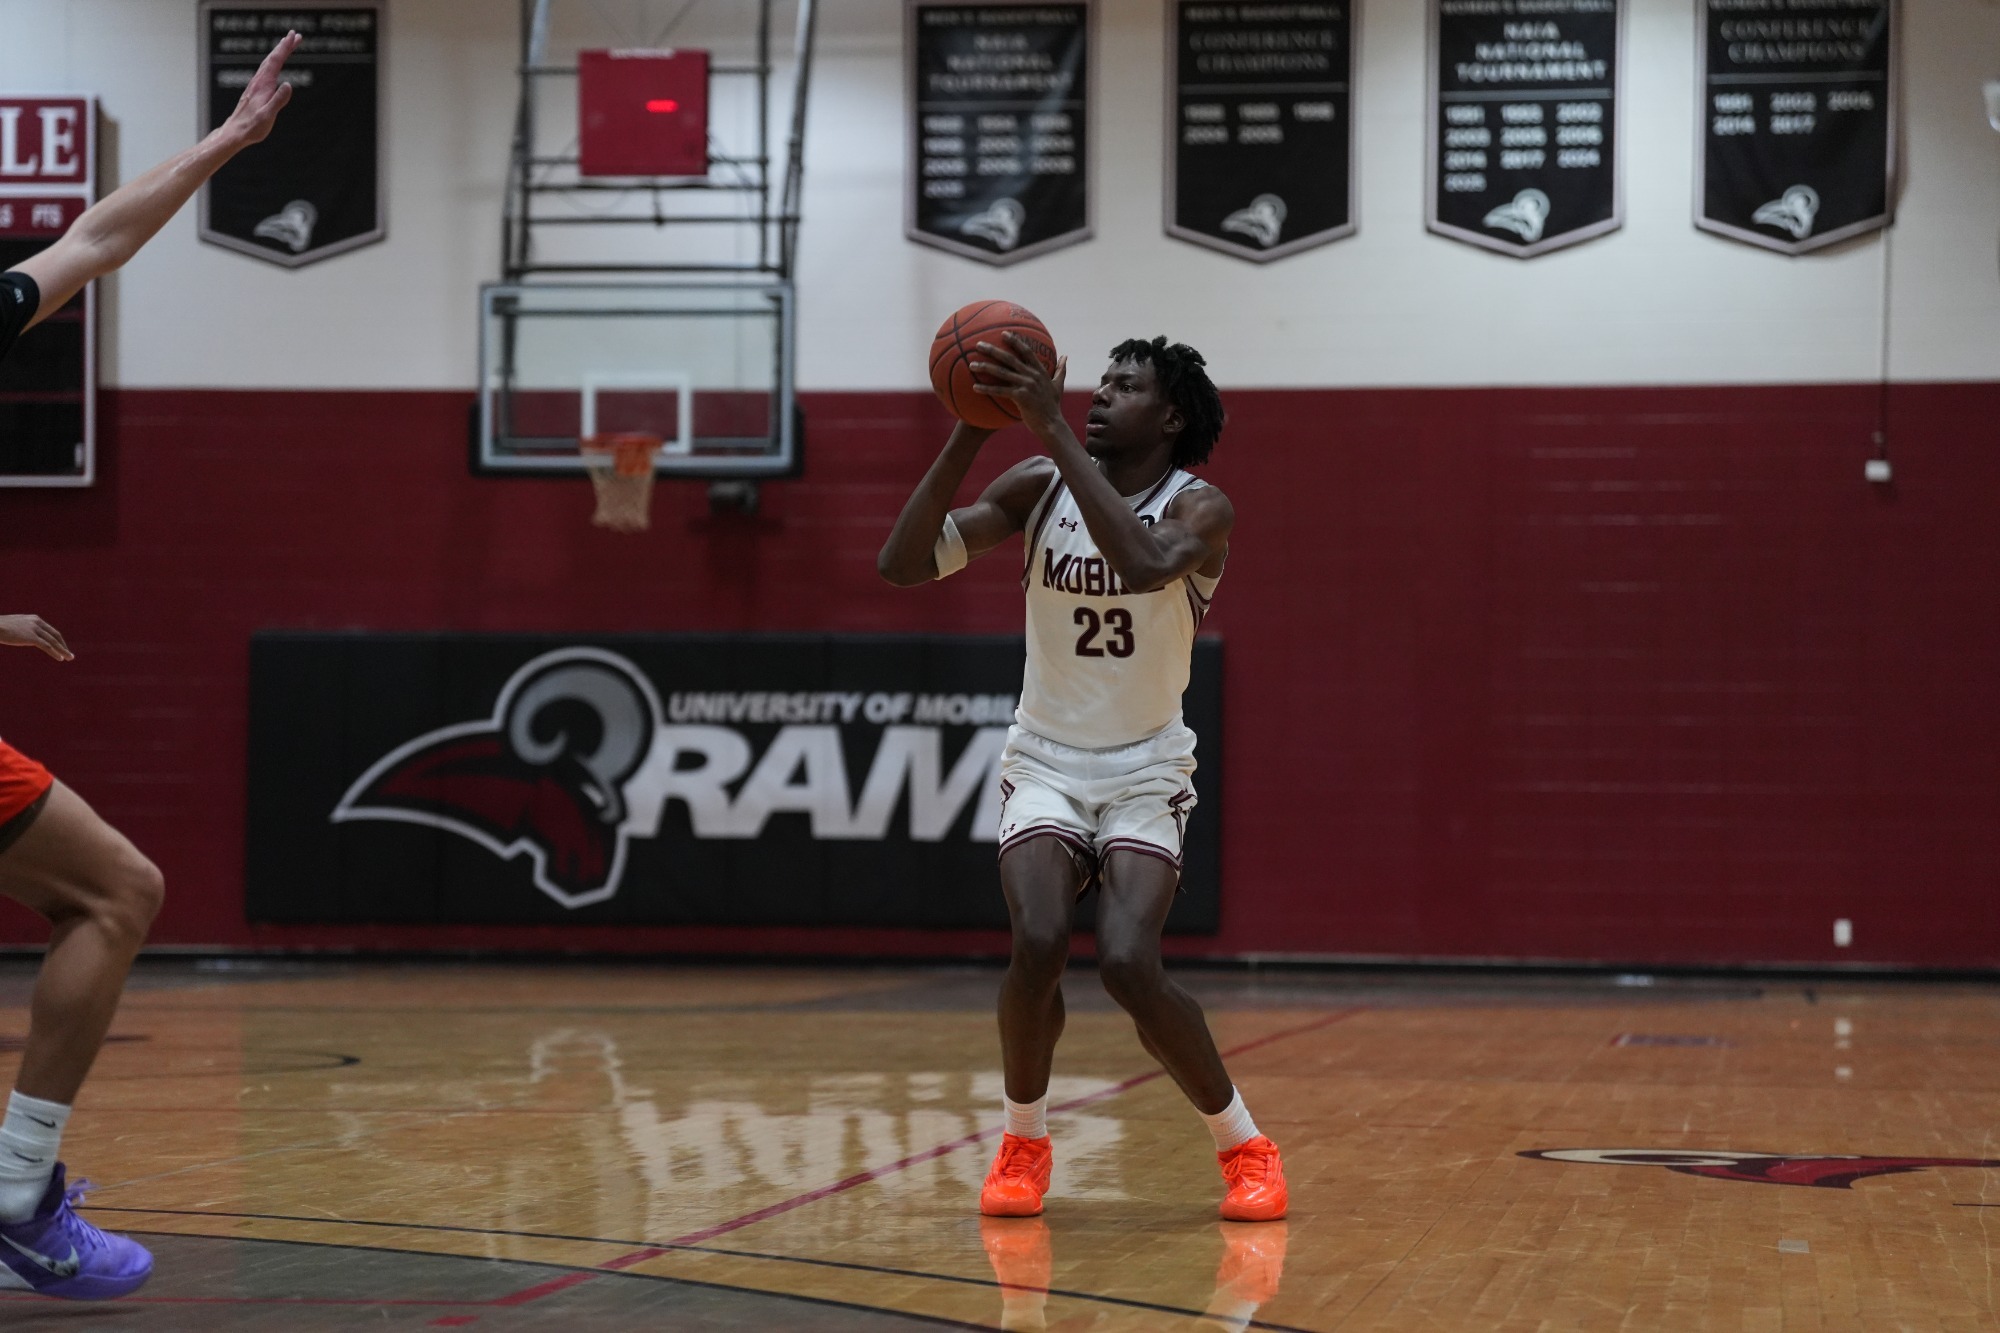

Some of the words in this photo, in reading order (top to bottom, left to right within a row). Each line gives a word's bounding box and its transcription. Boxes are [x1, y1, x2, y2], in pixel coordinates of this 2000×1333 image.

[1504, 22, 1560, 39] NAIA
[1476, 42, 1586, 61] NATIONAL
[1456, 61, 1607, 82] TOURNAMENT
[1043, 547, 1165, 597] MOBI
[1074, 607, 1135, 658] 23
[669, 692, 862, 722] UNIVERSITY
[864, 693, 912, 722] OF
